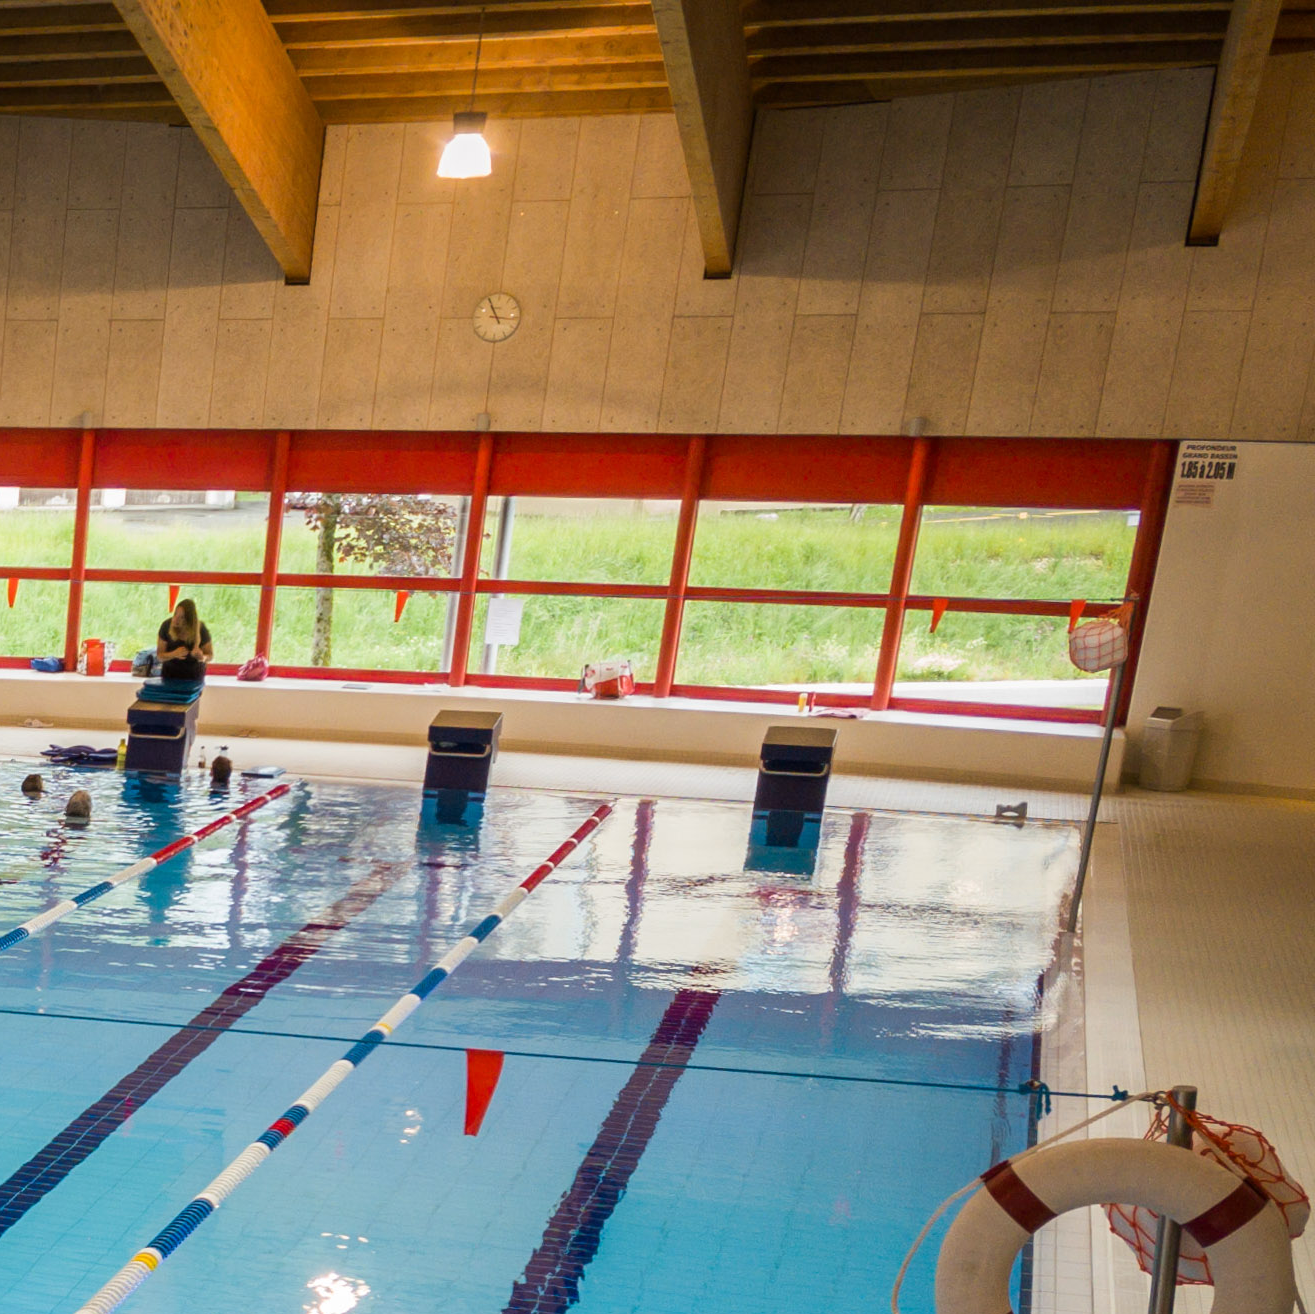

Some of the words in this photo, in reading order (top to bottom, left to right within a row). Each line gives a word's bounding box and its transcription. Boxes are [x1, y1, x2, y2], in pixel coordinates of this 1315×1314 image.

[1180, 461, 1199, 479] 1.85
[1206, 461, 1226, 480] 2.05
[1226, 462, 1236, 480] M
